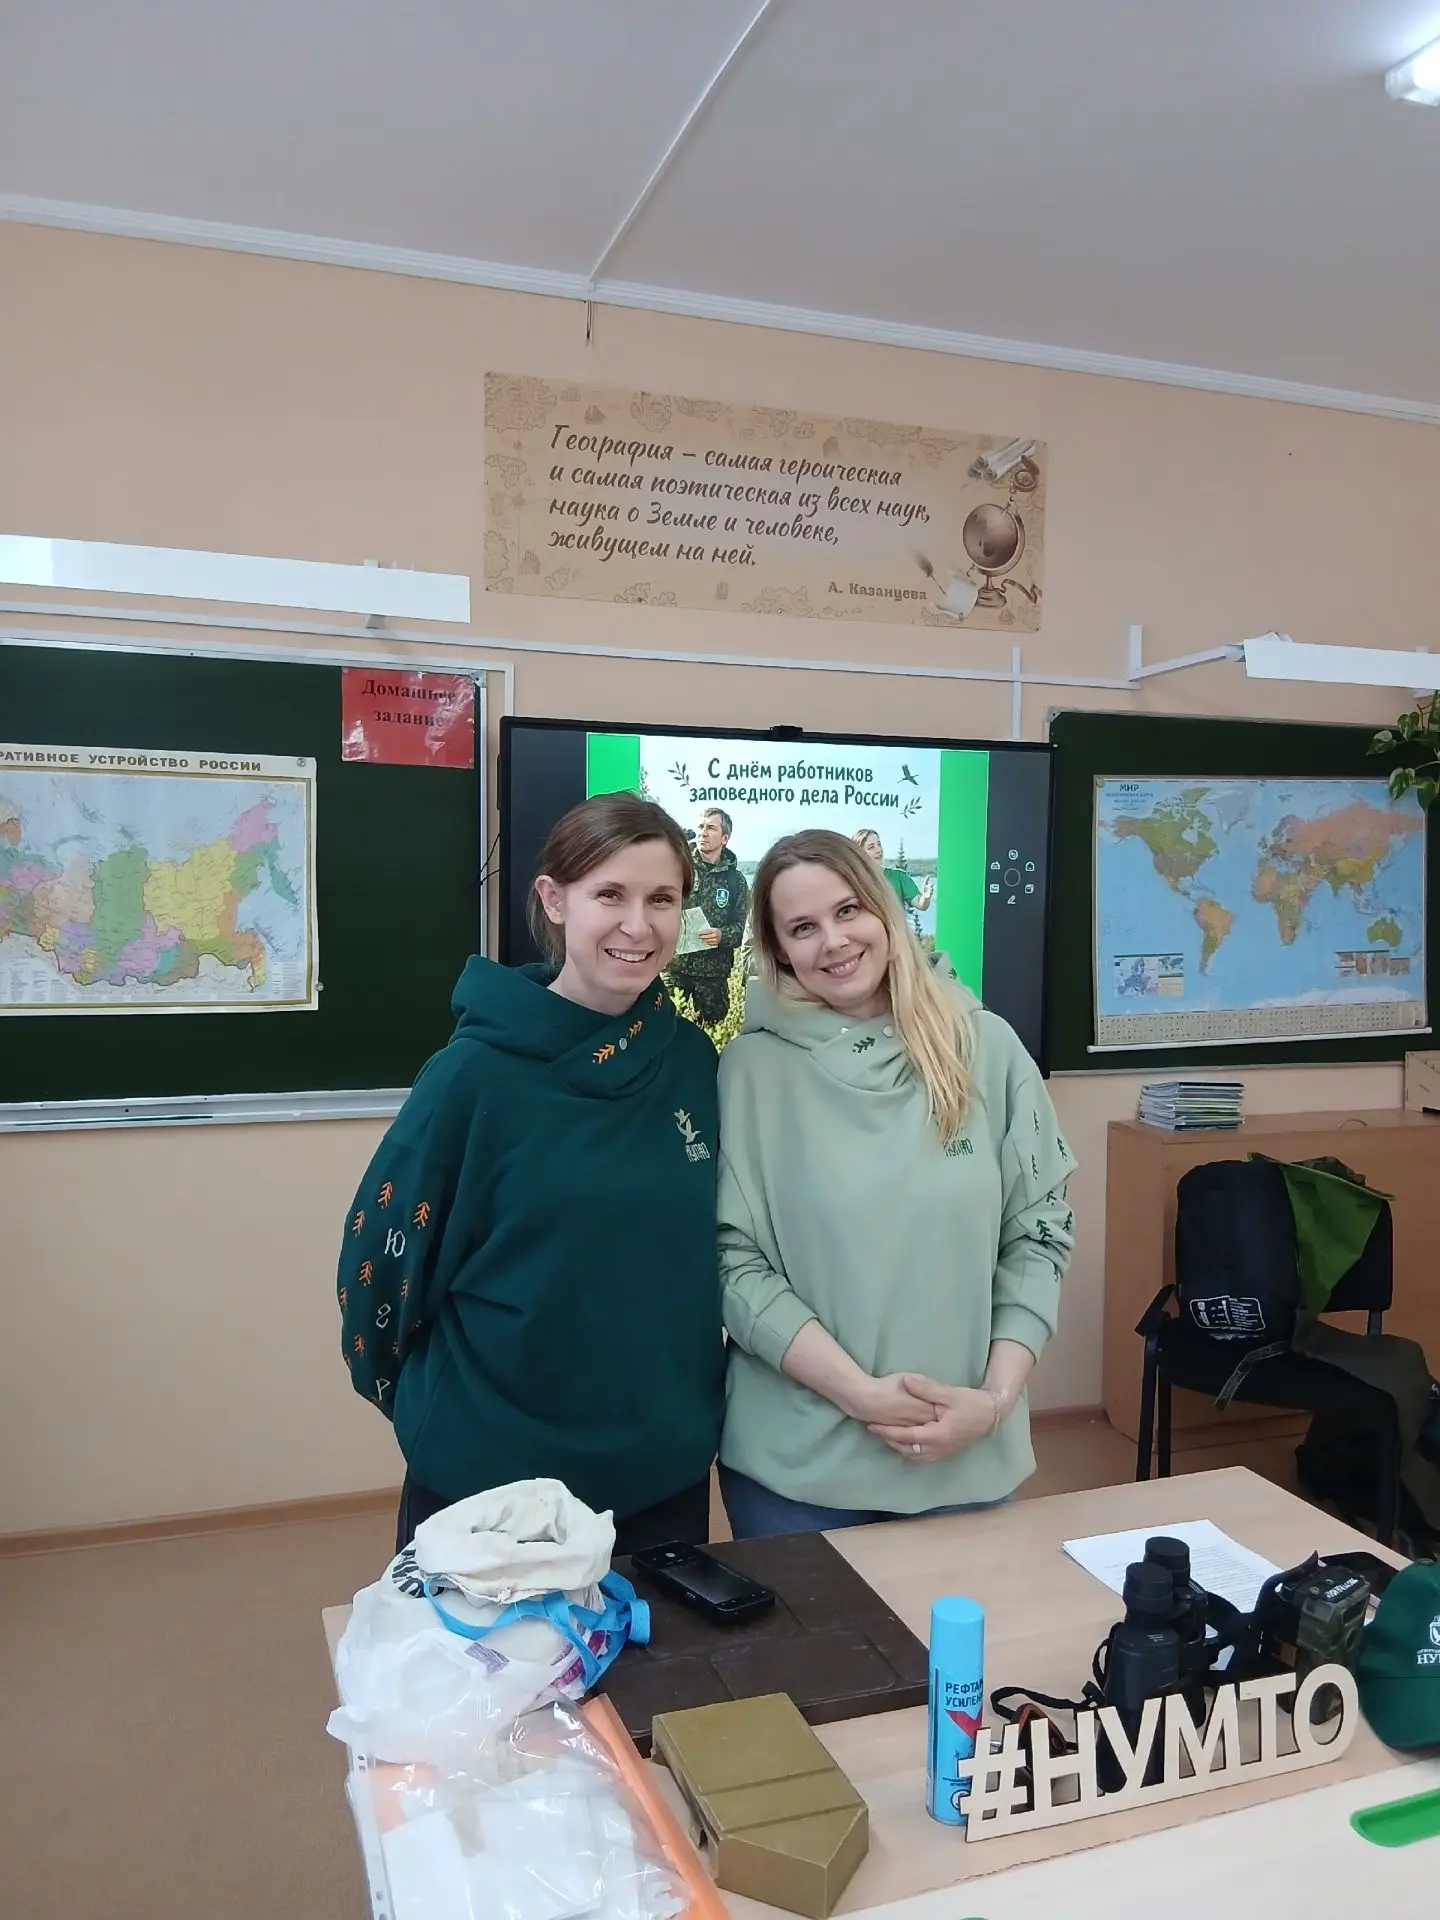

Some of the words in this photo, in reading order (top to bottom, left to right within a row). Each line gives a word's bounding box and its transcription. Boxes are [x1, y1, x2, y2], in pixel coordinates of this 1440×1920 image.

[551, 424, 674, 467] География
[704, 450, 772, 472] самая
[779, 458, 902, 486] героическая
[549, 465, 564, 481] и
[571, 467, 644, 490] самая
[650, 476, 791, 506] поэтическая
[798, 492, 821, 518] из
[827, 486, 872, 514] всех
[876, 500, 930, 526] наук,
[549, 498, 620, 527] наука
[627, 506, 640, 522] о
[646, 501, 718, 531] Земле
[724, 516, 738, 532] и
[745, 513, 839, 545] человеке,
[548, 525, 671, 562] живущем
[676, 544, 704, 561] на
[711, 543, 756, 566] ней.
[828, 581, 843, 594] А.
[849, 583, 927, 602] Казанцева
[89, 753, 189, 769] УСТРОЙСТВО
[200, 759, 261, 772] РОССИИ
[707, 757, 721, 779] С
[726, 761, 772, 781] днём
[778, 760, 873, 782] работников
[689, 786, 795, 804] заповедного
[800, 788, 839, 806] дела
[844, 785, 899, 808] России
[1119, 783, 1140, 792] МИР
[957, 1662, 1360, 1840] #НУМТО
